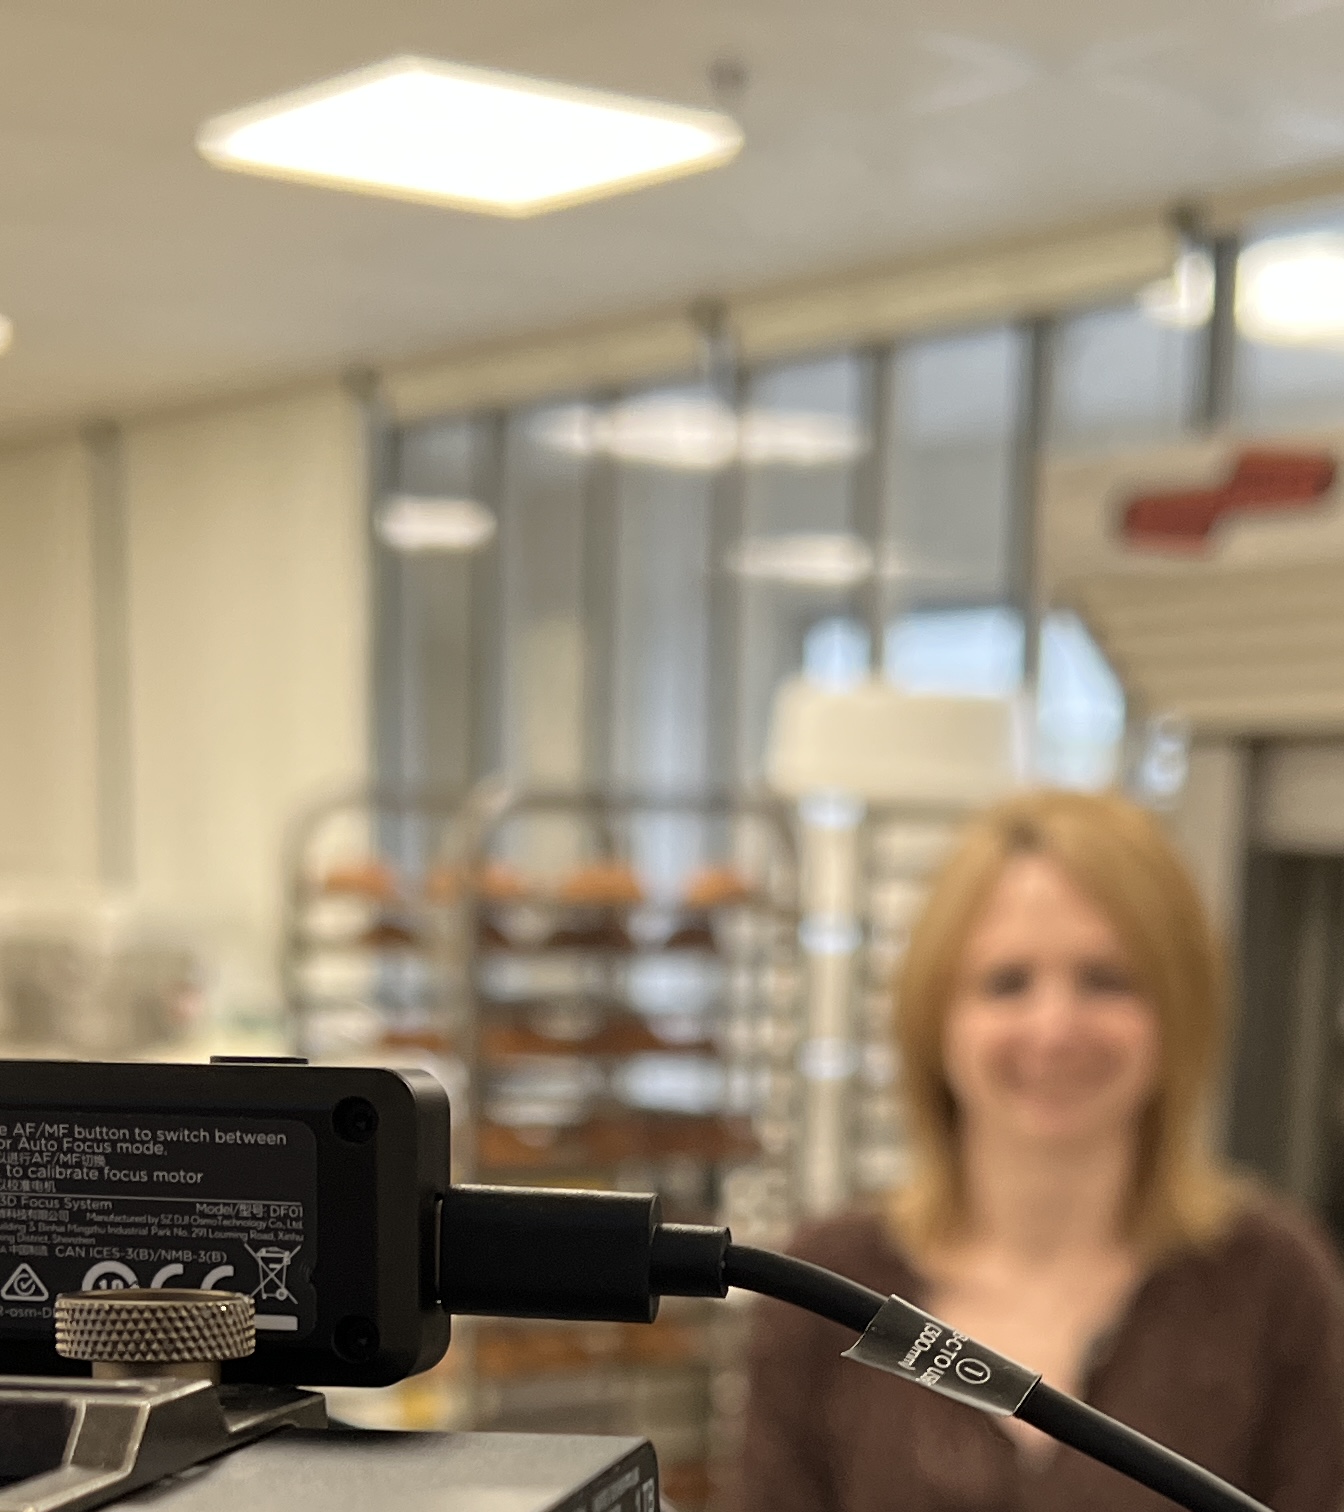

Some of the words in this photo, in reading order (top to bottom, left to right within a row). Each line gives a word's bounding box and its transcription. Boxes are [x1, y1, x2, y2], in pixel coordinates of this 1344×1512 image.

[12, 1122, 70, 1139] AF/MF
[74, 1124, 130, 1140] button
[134, 1127, 152, 1141] to
[156, 1127, 210, 1143] switch
[214, 1128, 287, 1146] between
[17, 1136, 58, 1151] Auto
[62, 1138, 112, 1154] Focus
[116, 1140, 168, 1156] mode.
[6, 1164, 23, 1178] to
[27, 1164, 99, 1180] calibrate
[103, 1166, 149, 1182] focus
[152, 1169, 204, 1184] motor
[0, 1194, 17, 1207] 3D
[21, 1196, 60, 1208] Focus
[63, 1197, 113, 1211] System
[269, 1205, 304, 1218] DF01
[55, 1246, 85, 1258] CAN
[89, 1247, 228, 1263] ICES-3(B)/NMB-3(B)
